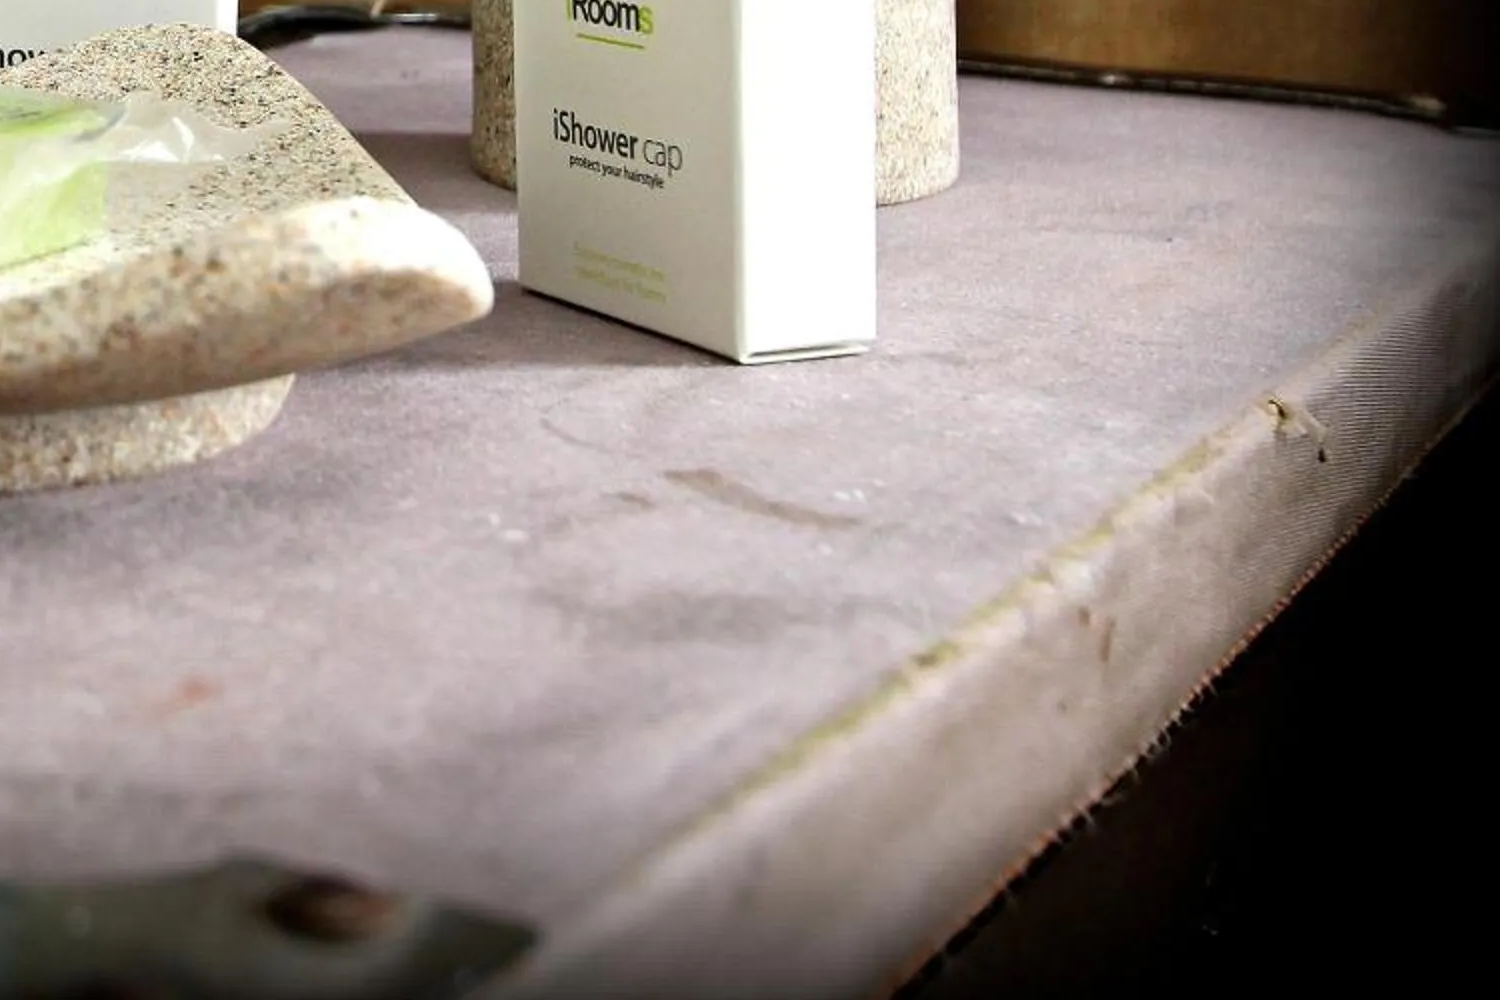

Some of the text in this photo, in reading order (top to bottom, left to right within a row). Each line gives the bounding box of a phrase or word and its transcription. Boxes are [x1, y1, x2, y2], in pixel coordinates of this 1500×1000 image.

[553, 107, 684, 177] iShower cap
[601, 164, 623, 177] your
